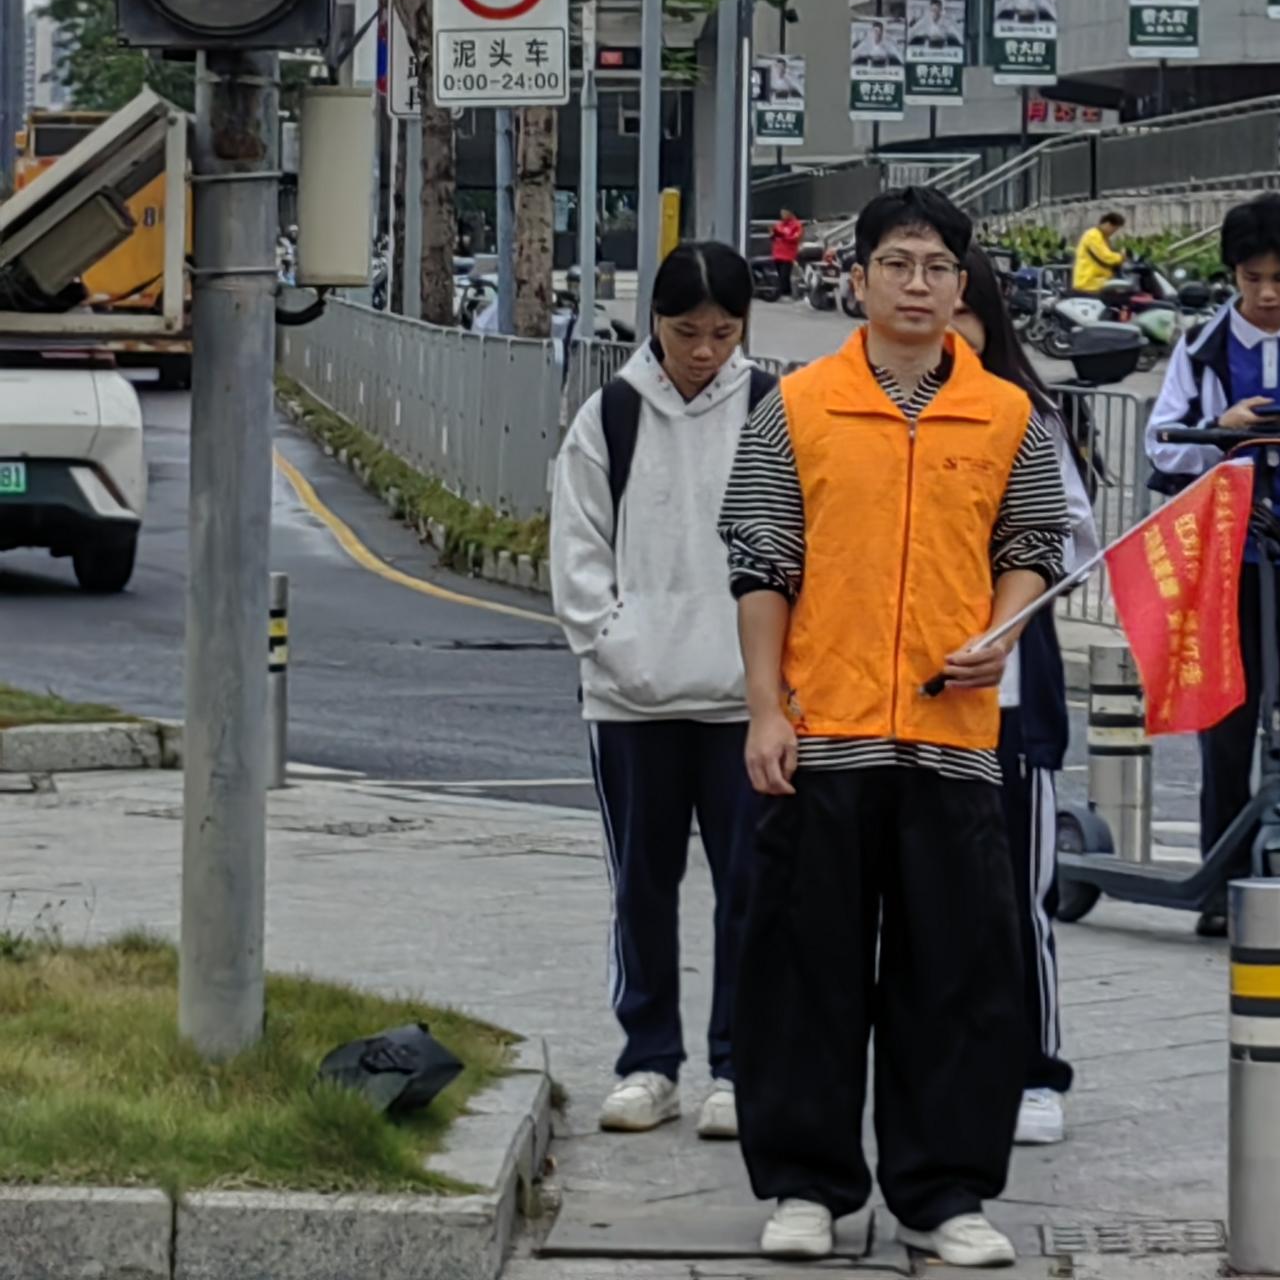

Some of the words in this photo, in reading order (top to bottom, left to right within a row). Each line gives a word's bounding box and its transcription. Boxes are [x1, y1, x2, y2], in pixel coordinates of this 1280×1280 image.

[453, 38, 549, 68] 泥头车
[443, 72, 559, 92] 0:00-24:00
